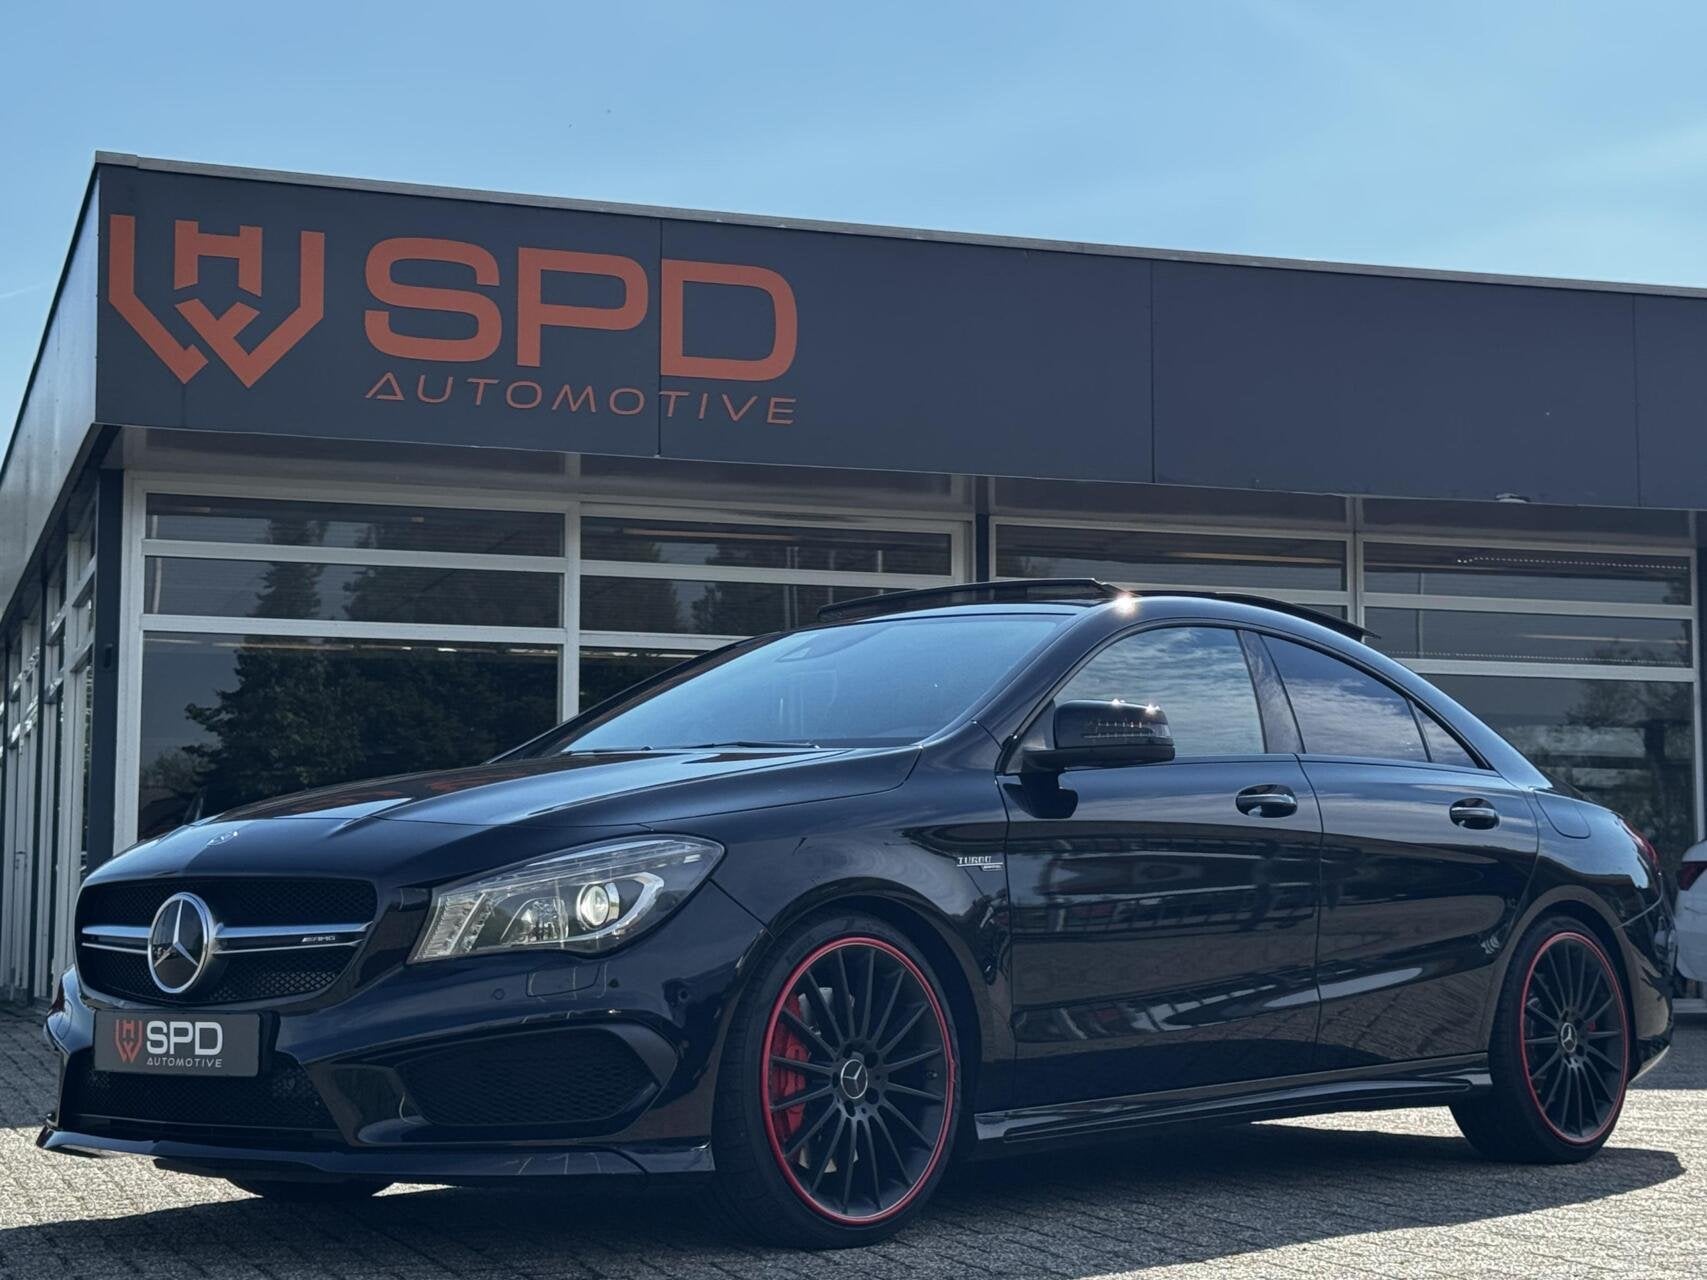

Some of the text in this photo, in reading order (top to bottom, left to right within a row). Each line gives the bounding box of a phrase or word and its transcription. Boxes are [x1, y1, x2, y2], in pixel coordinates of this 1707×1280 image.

[364, 237, 799, 382] SPD
[365, 372, 797, 425] AUTOMOTIVE
[146, 1020, 223, 1056] SPD
[147, 1057, 222, 1068] AUTOMOTIVE
